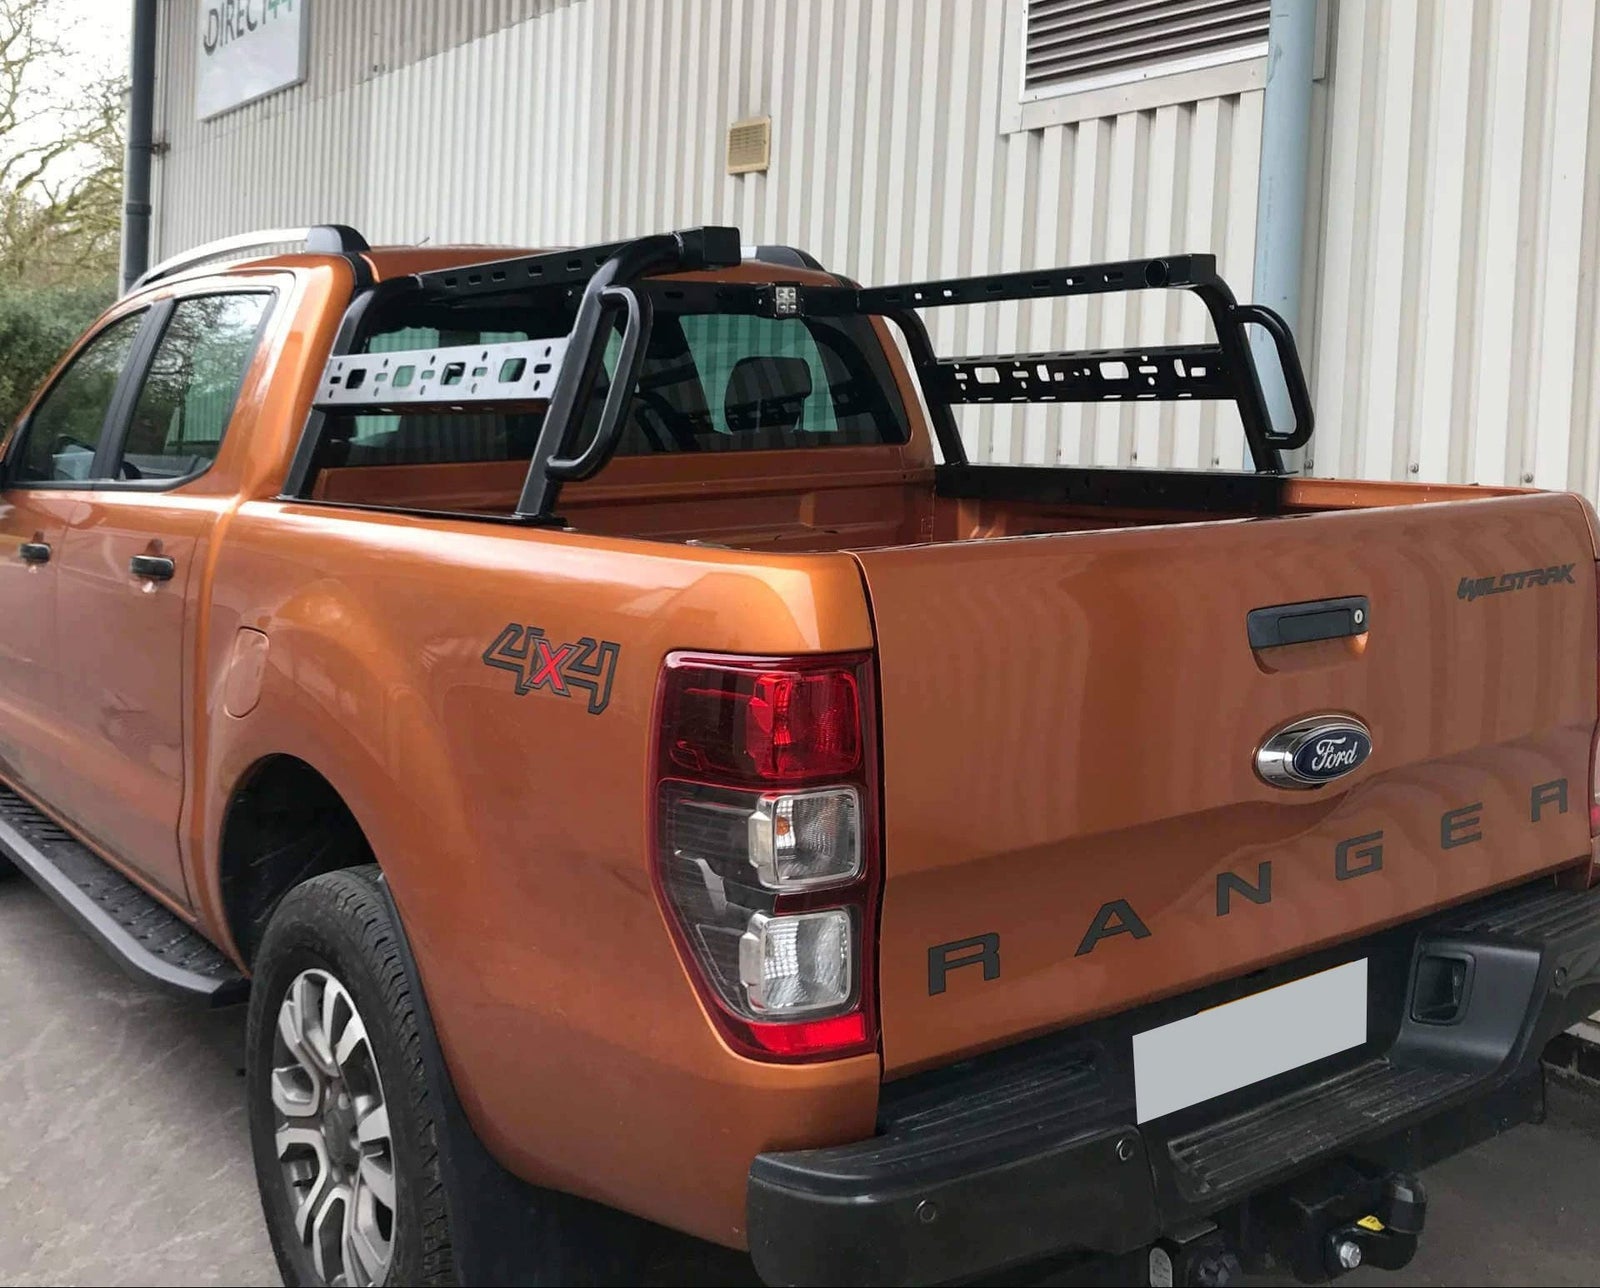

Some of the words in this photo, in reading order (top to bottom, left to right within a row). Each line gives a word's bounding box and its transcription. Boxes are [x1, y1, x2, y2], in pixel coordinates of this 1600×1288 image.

[1457, 563, 1576, 602] WILDTRAK
[1312, 737, 1357, 771] Ford
[928, 778, 1568, 996] RANGER
